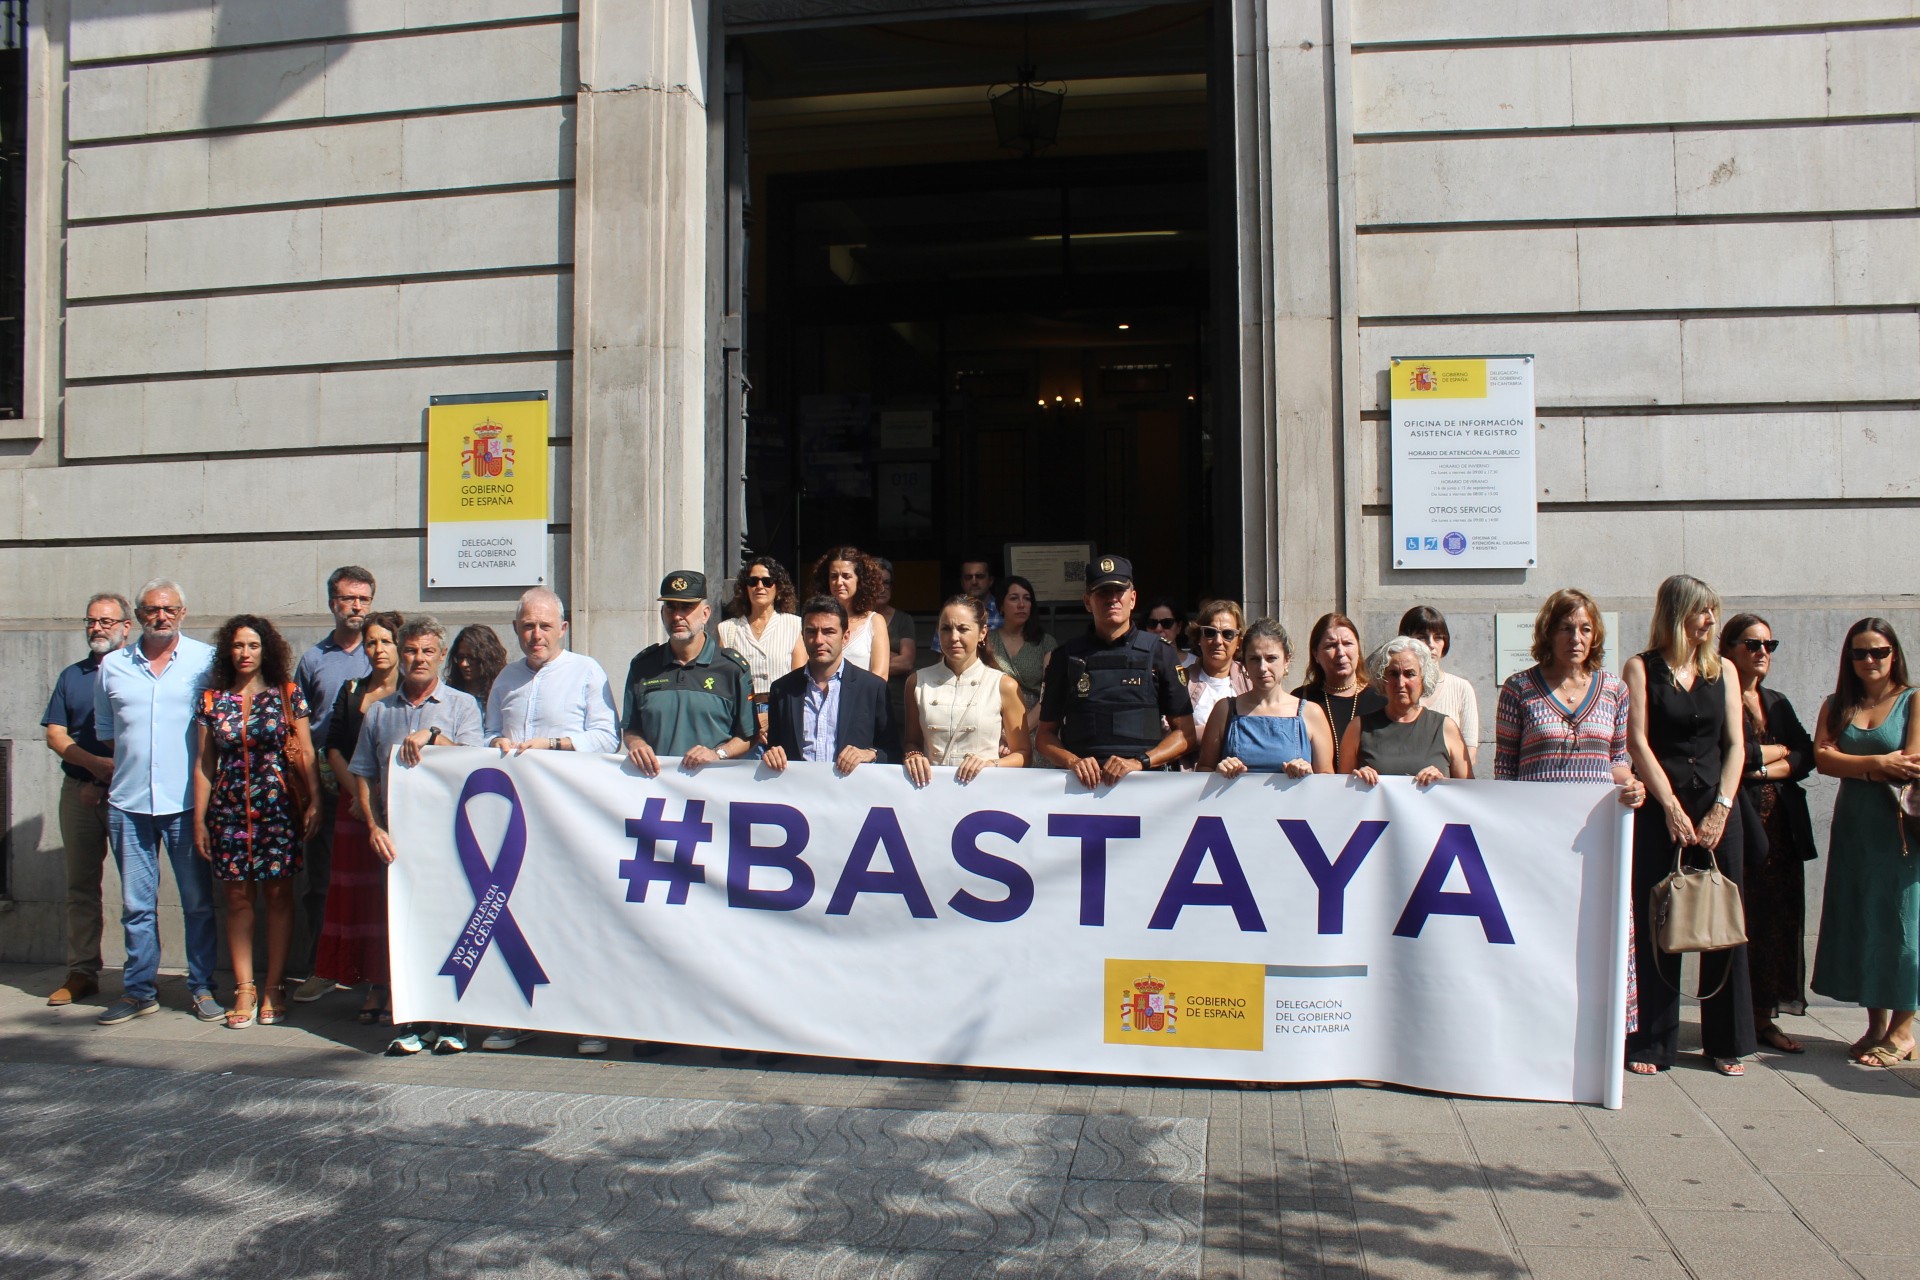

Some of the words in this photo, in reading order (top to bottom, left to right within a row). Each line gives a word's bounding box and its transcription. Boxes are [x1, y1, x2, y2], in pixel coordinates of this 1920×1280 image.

[1459, 418, 1524, 426] INFORMACIÓN
[461, 484, 514, 494] GOBIERNO
[461, 497, 474, 506] DE
[477, 495, 514, 506] ESPAÑA
[462, 537, 513, 546] DELEGACIÓN
[618, 796, 1516, 945] #BASTAYA
[452, 946, 466, 964] NO
[466, 884, 499, 936] VIOLENCIA
[462, 946, 479, 970] DE
[474, 891, 507, 946] GENERO
[1186, 996, 1246, 1008] GOBIERNO
[1276, 998, 1343, 1009] DELEGACIÓN
[1186, 1008, 1200, 1017] DE
[1204, 1008, 1245, 1019] ESPAÑA
[1276, 1012, 1295, 1022] DEL
[1298, 1012, 1352, 1021] GOBIERNO
[1275, 1025, 1290, 1034] EN
[1292, 1024, 1350, 1034] CANTABRIA
